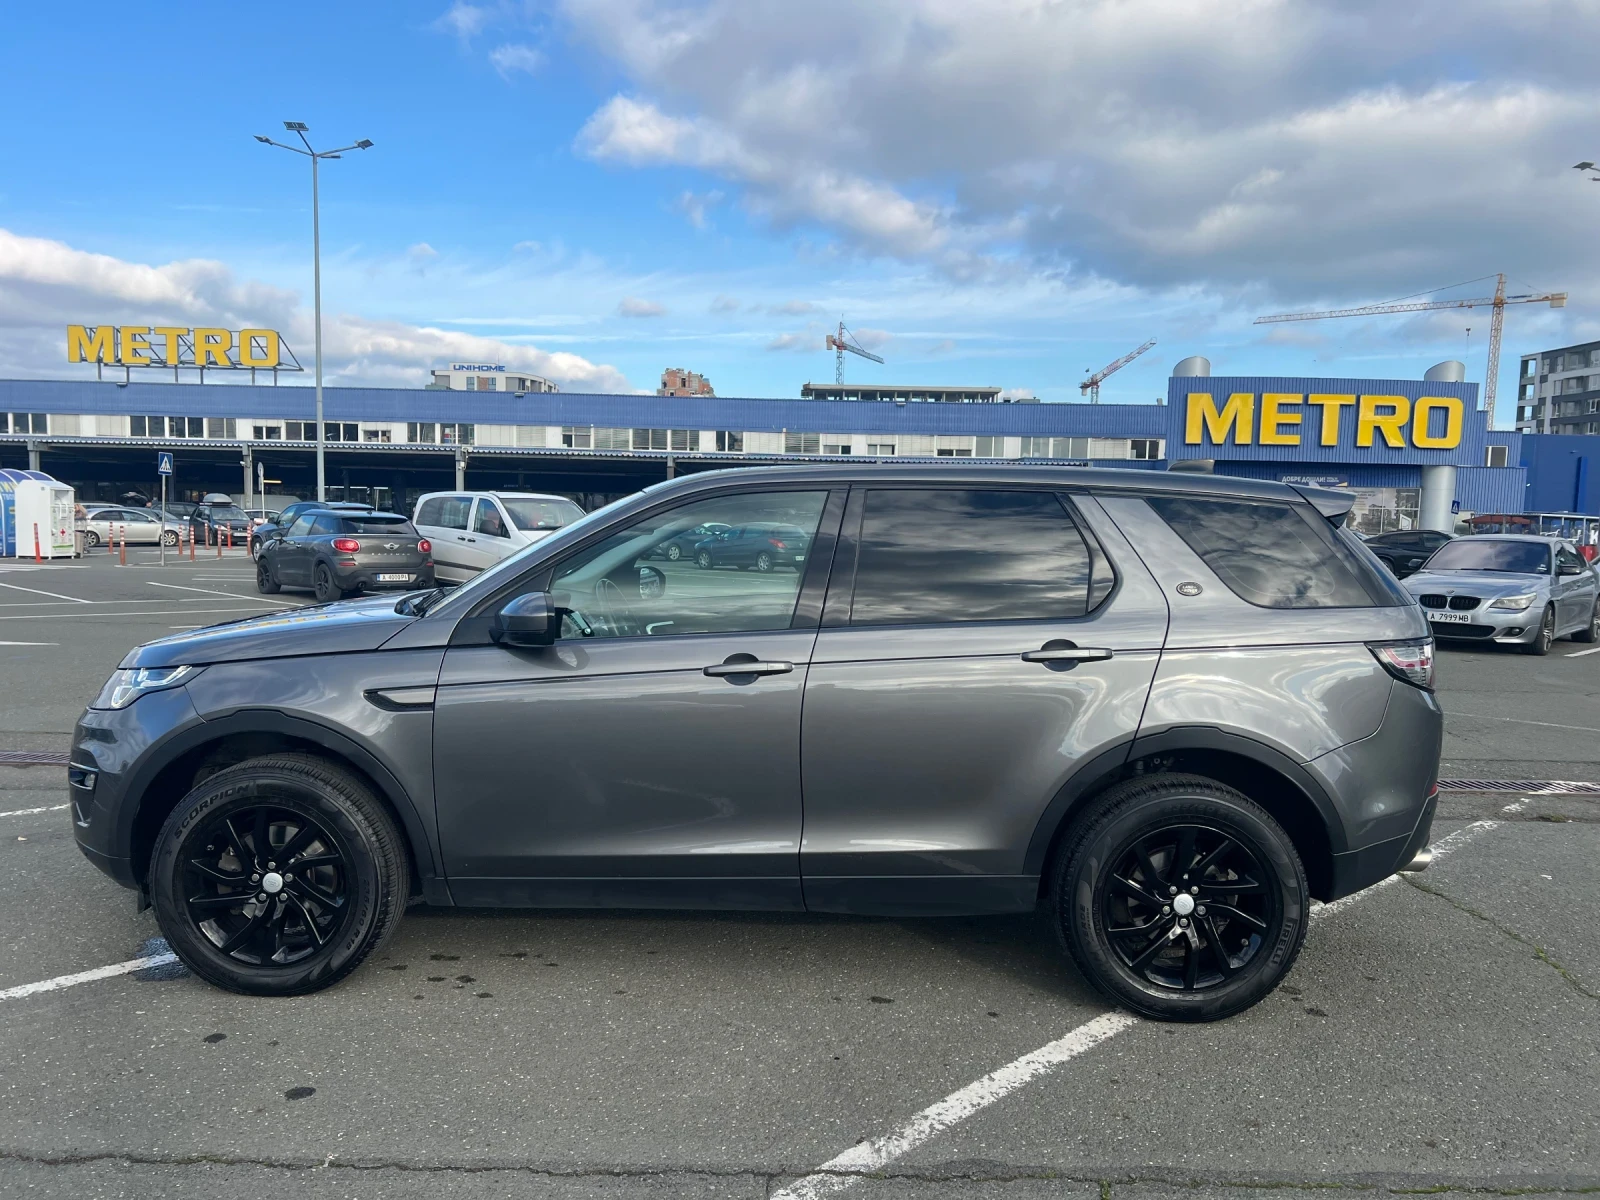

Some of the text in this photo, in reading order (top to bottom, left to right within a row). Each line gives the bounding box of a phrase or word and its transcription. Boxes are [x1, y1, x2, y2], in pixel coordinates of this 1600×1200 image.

[67, 325, 280, 367] METRO
[453, 364, 506, 372] UNIHOME
[1185, 393, 1464, 448] METRO
[174, 784, 250, 839] SCORPION
[1270, 916, 1299, 965] PIRELLI
